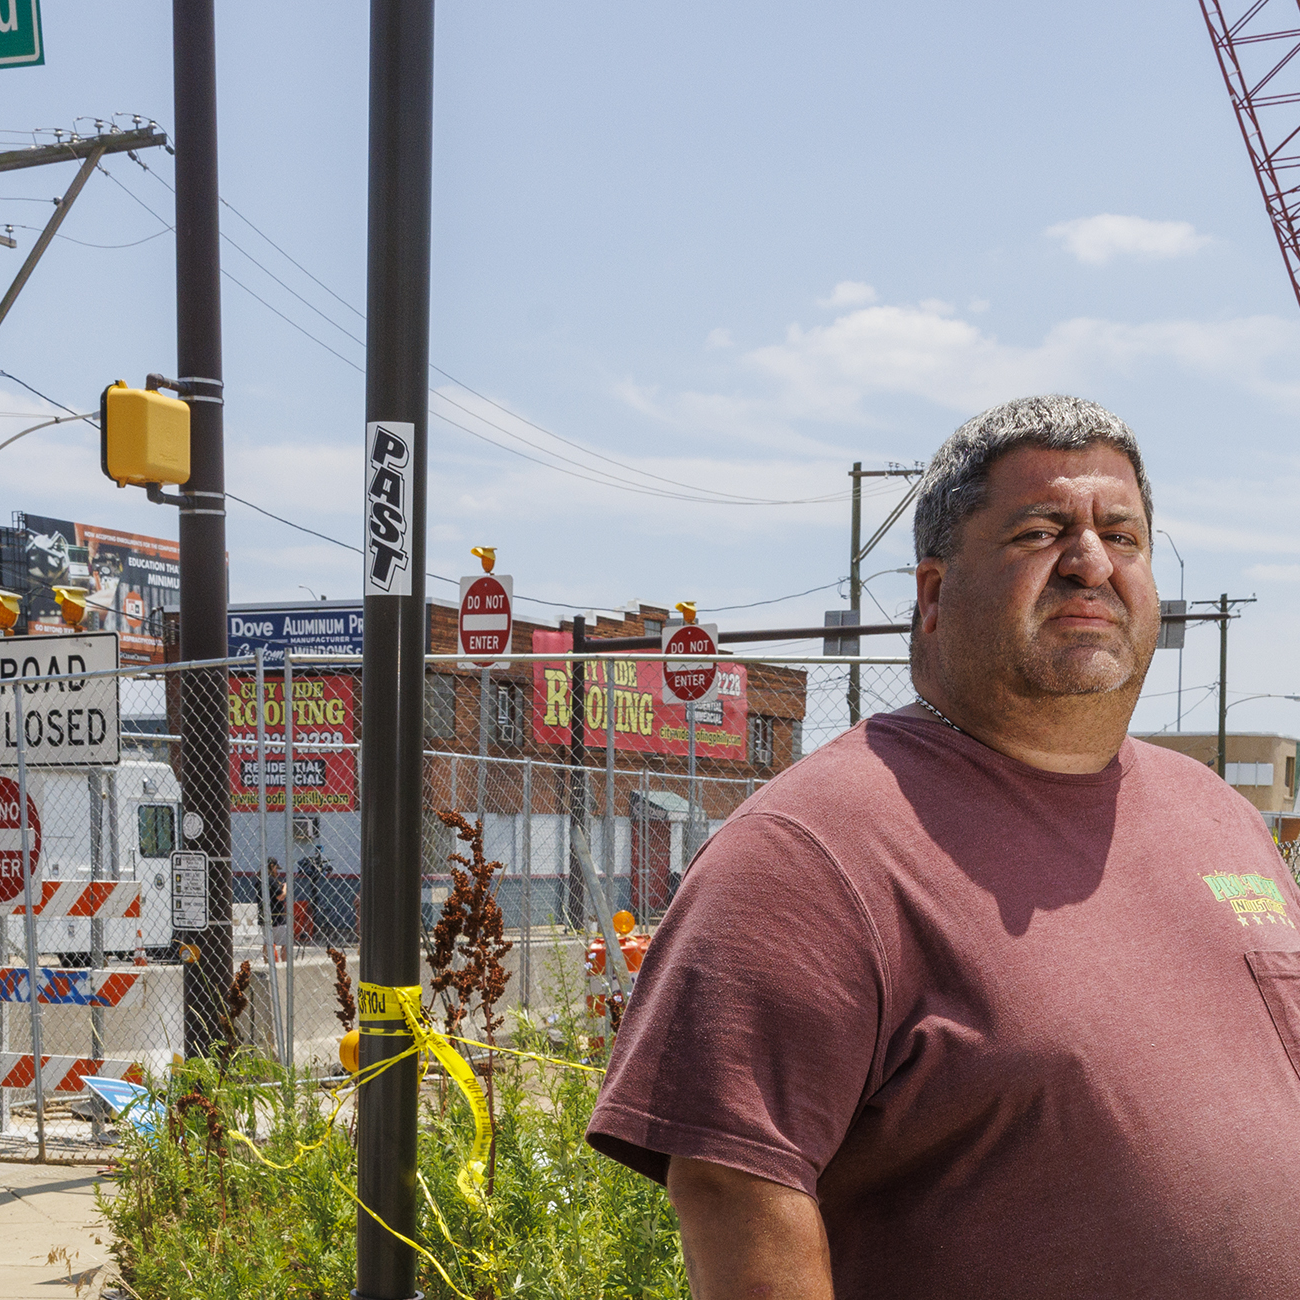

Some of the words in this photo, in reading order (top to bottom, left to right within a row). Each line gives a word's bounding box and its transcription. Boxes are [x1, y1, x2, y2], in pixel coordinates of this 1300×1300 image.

[368, 425, 409, 592] PAST
[84, 531, 95, 539] NOW
[128, 557, 166, 573] EDUCATION
[166, 564, 180, 575] THA
[147, 574, 180, 589] MINIMU
[467, 596, 481, 609] DO
[485, 595, 505, 609] NOT
[35, 624, 43, 632] GO
[231, 618, 274, 637] Dove
[282, 616, 344, 635] ALUMINUM
[349, 614, 363, 634] PR
[290, 636, 350, 644] MANUFACTURER
[469, 636, 499, 650] ENTER
[670, 642, 684, 654] DO
[689, 640, 709, 652] NOT
[0, 654, 87, 695] ROAD
[674, 675, 706, 687] ENTER
[718, 671, 741, 697] 2228
